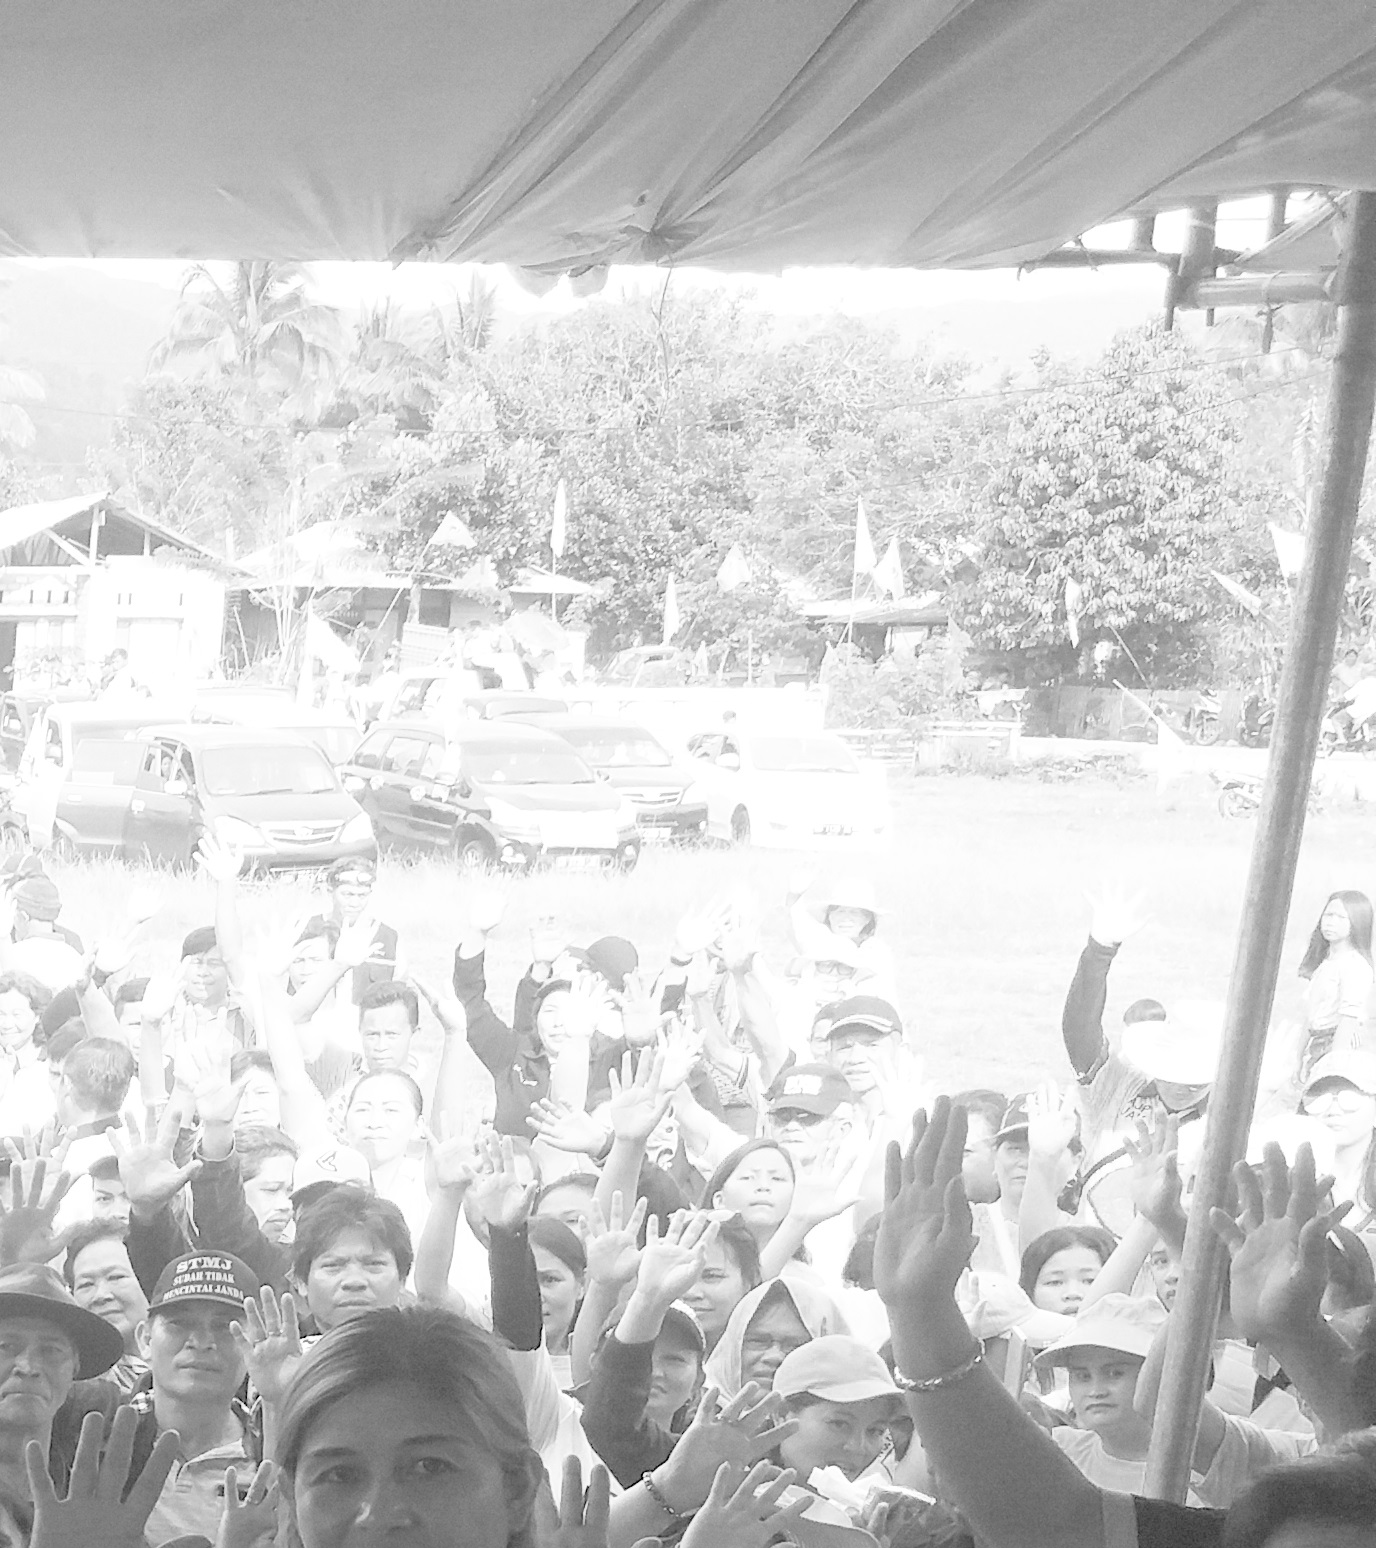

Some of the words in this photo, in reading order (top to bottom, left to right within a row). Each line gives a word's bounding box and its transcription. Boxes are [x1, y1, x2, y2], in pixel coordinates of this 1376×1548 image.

[176, 1256, 233, 1274] STMJ
[172, 1271, 204, 1287] SUDAH
[205, 1271, 235, 1284] TIDAK
[163, 1284, 213, 1301] MENCINTAI
